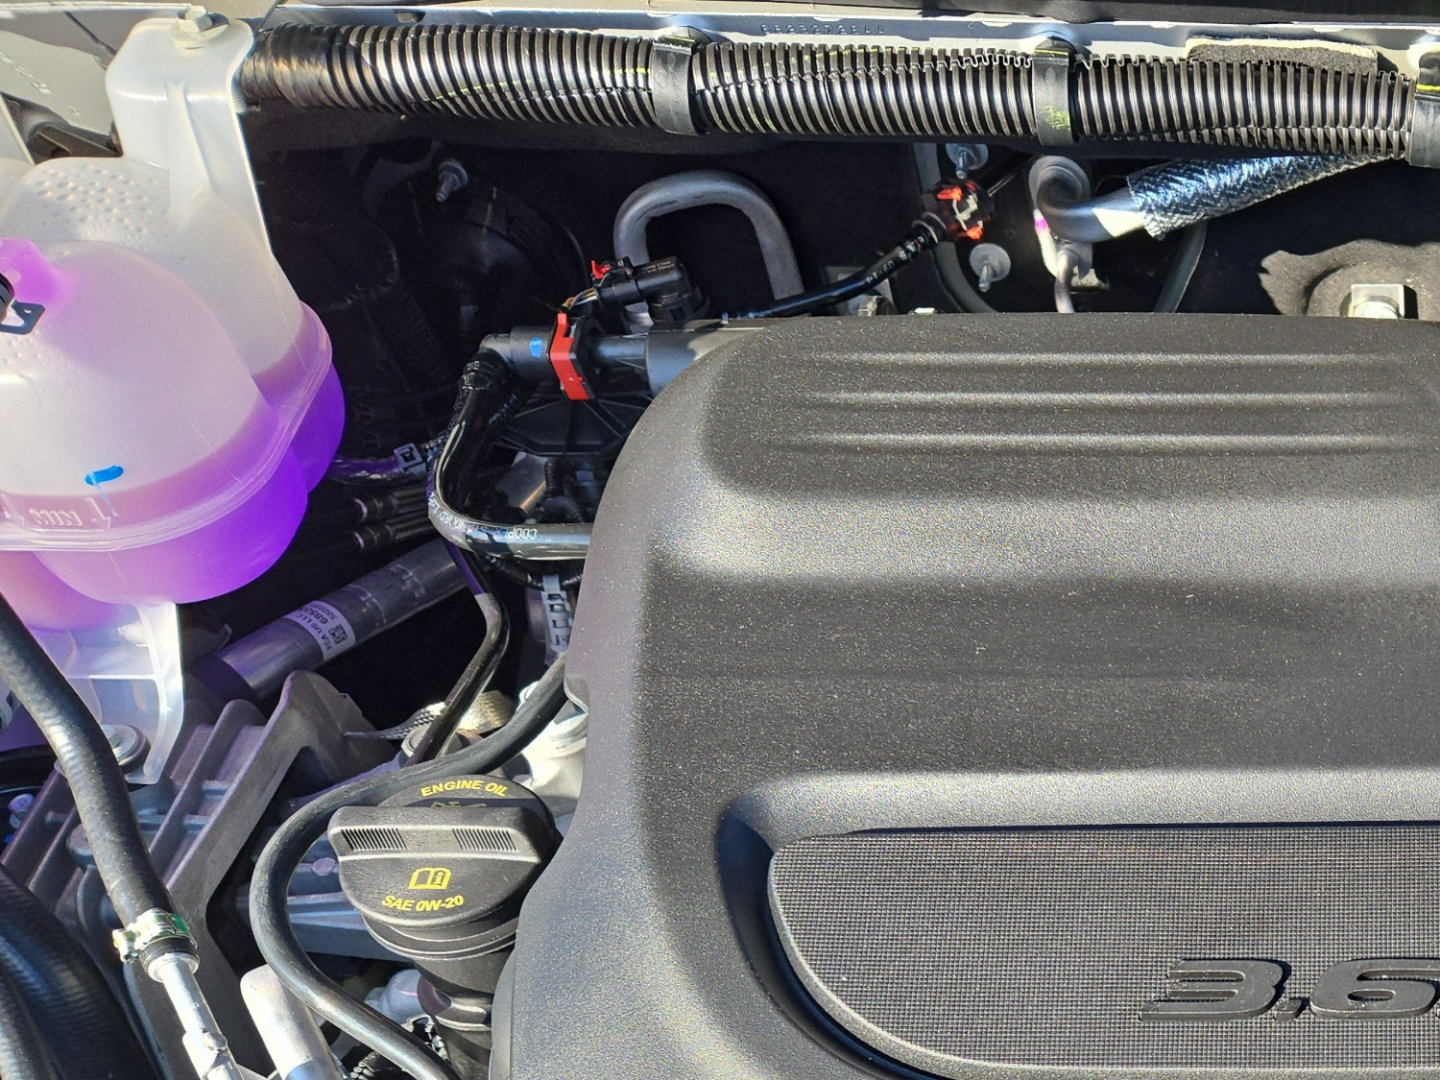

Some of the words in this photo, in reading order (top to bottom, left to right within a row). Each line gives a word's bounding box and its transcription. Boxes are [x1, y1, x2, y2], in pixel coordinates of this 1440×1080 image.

[421, 780, 484, 797] ENGINE
[485, 782, 508, 797] OIL
[382, 895, 415, 911] SAE
[416, 895, 464, 911] 0W-20
